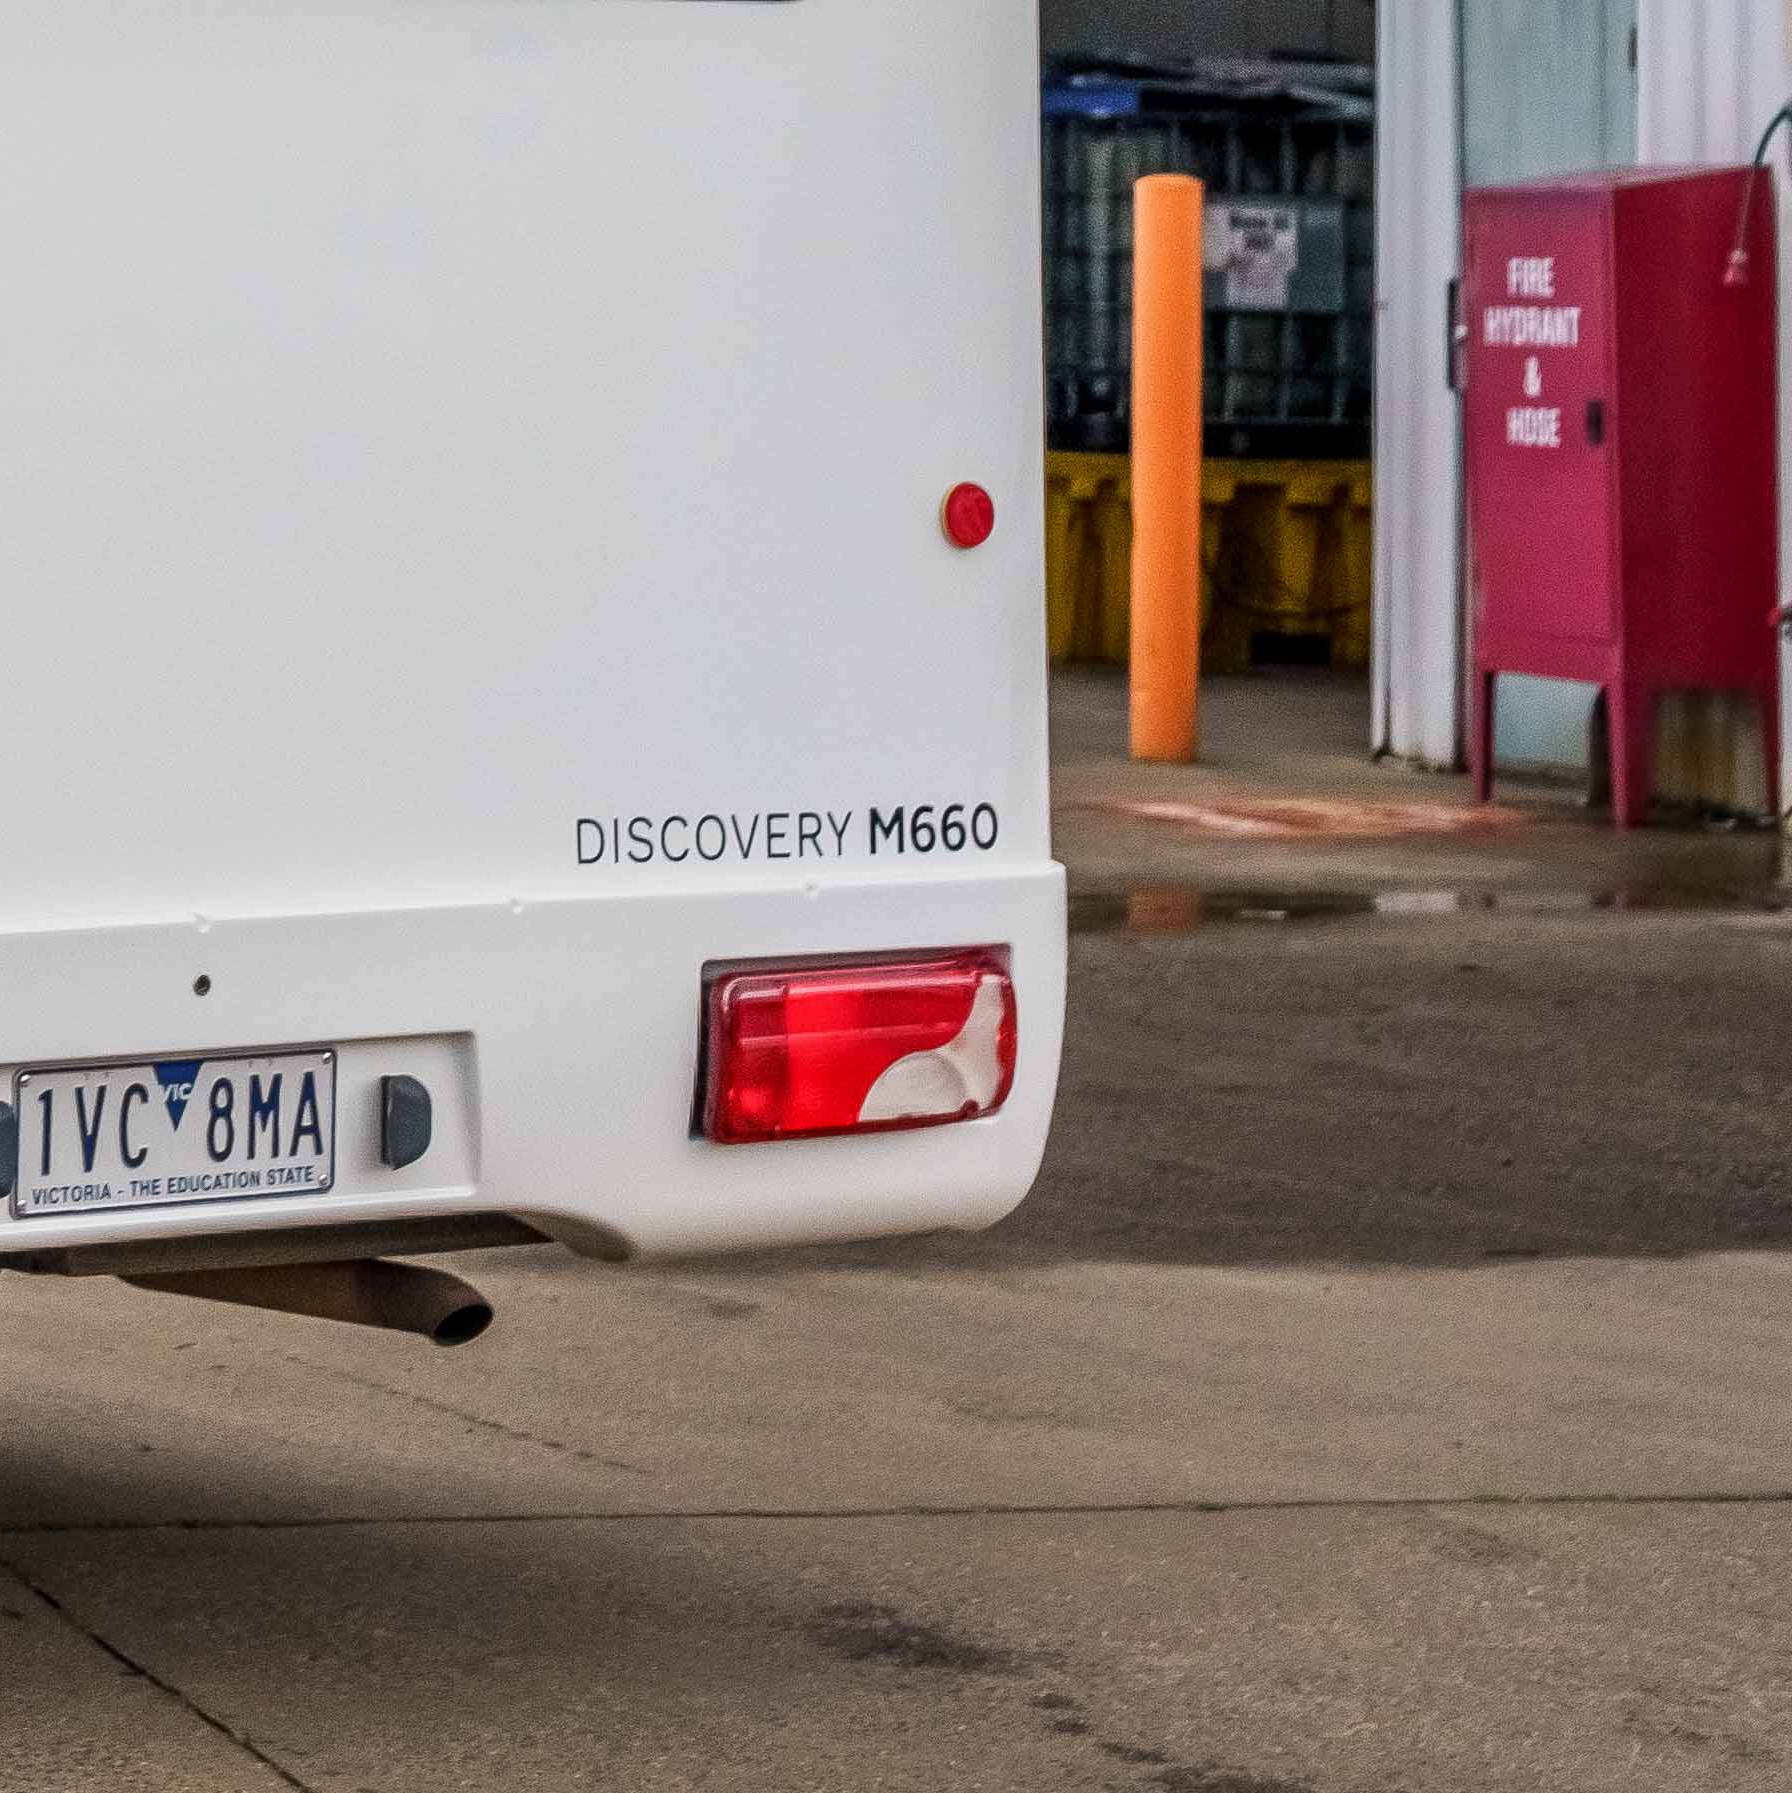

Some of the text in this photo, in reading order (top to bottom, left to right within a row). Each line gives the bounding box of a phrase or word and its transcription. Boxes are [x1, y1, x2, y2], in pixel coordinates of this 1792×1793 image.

[1506, 256, 1556, 299] FIRE
[1484, 305, 1581, 347] HYDRANT
[1506, 406, 1561, 448] HOSE
[575, 801, 999, 865] DISCOVERY M660
[159, 1082, 193, 1103] VIC
[36, 1070, 324, 1177] 1VC 8MA
[30, 1182, 112, 1205] VICTORIA
[129, 1177, 161, 1196] THE
[166, 1170, 261, 1195] EDUCATION
[265, 1165, 316, 1186] STATE
